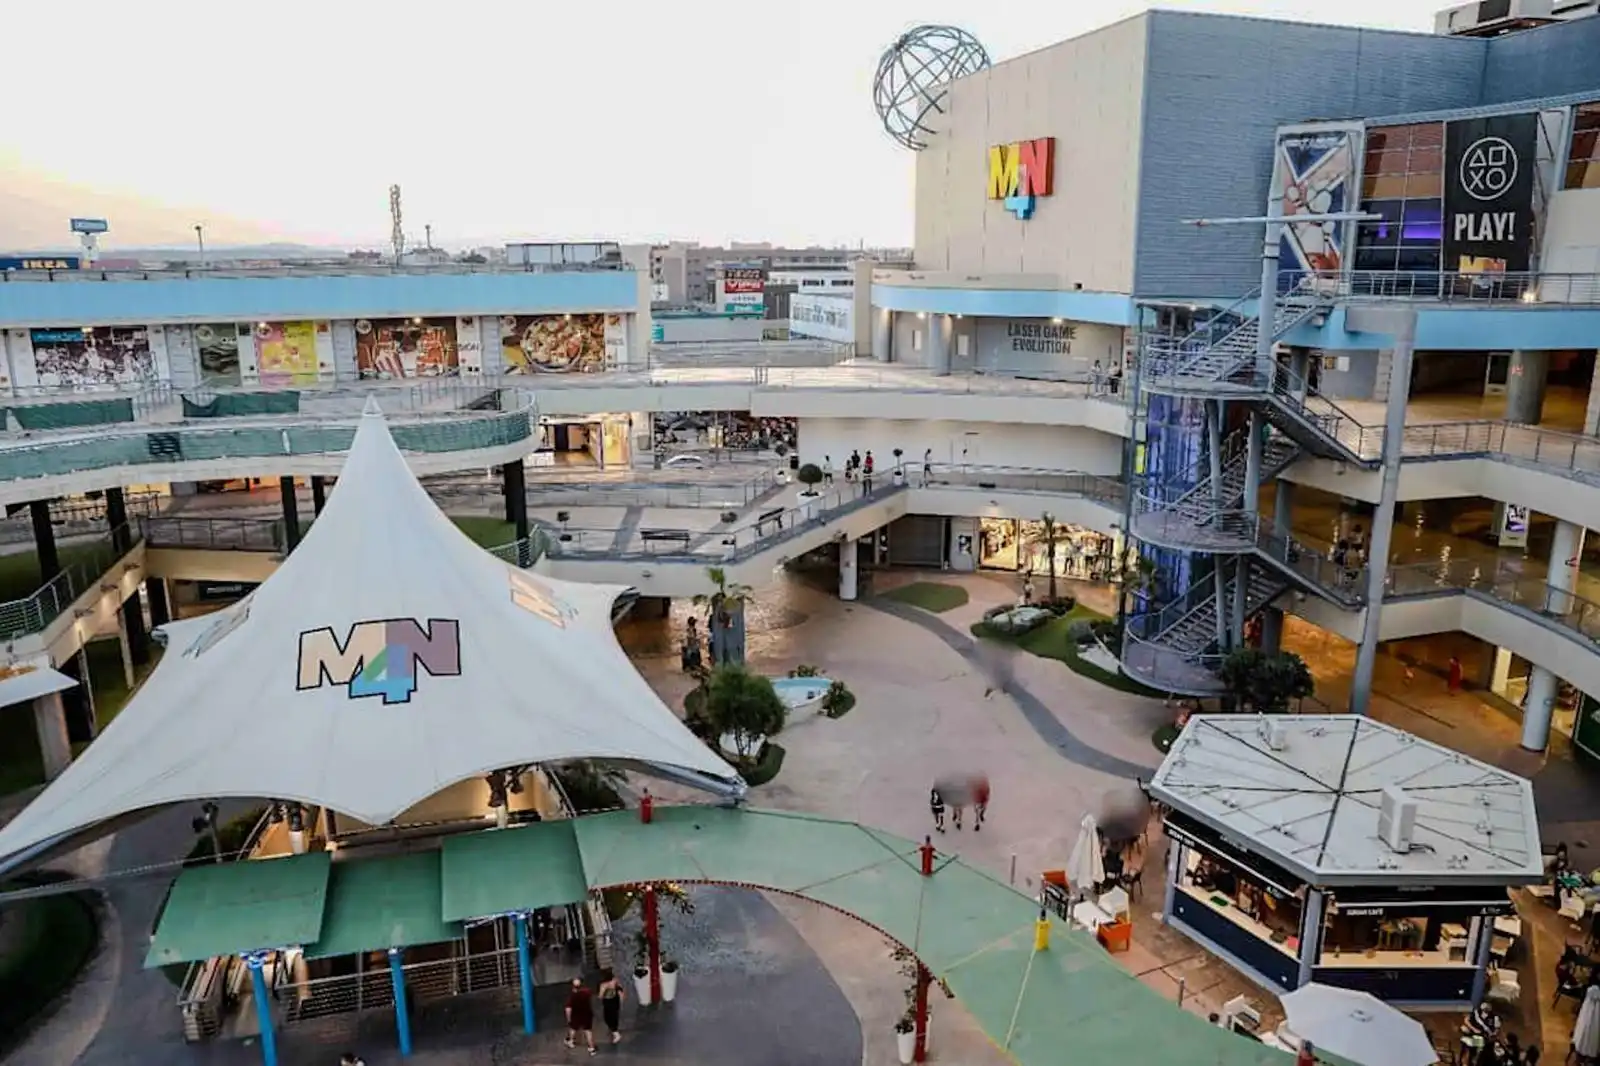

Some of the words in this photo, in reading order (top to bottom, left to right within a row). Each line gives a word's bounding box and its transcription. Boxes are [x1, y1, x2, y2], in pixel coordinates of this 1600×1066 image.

[1454, 212, 1516, 241] PLAY!
[1007, 321, 1041, 337] LASER
[1043, 325, 1077, 340] GAME
[1012, 338, 1071, 354] EVOLUTION
